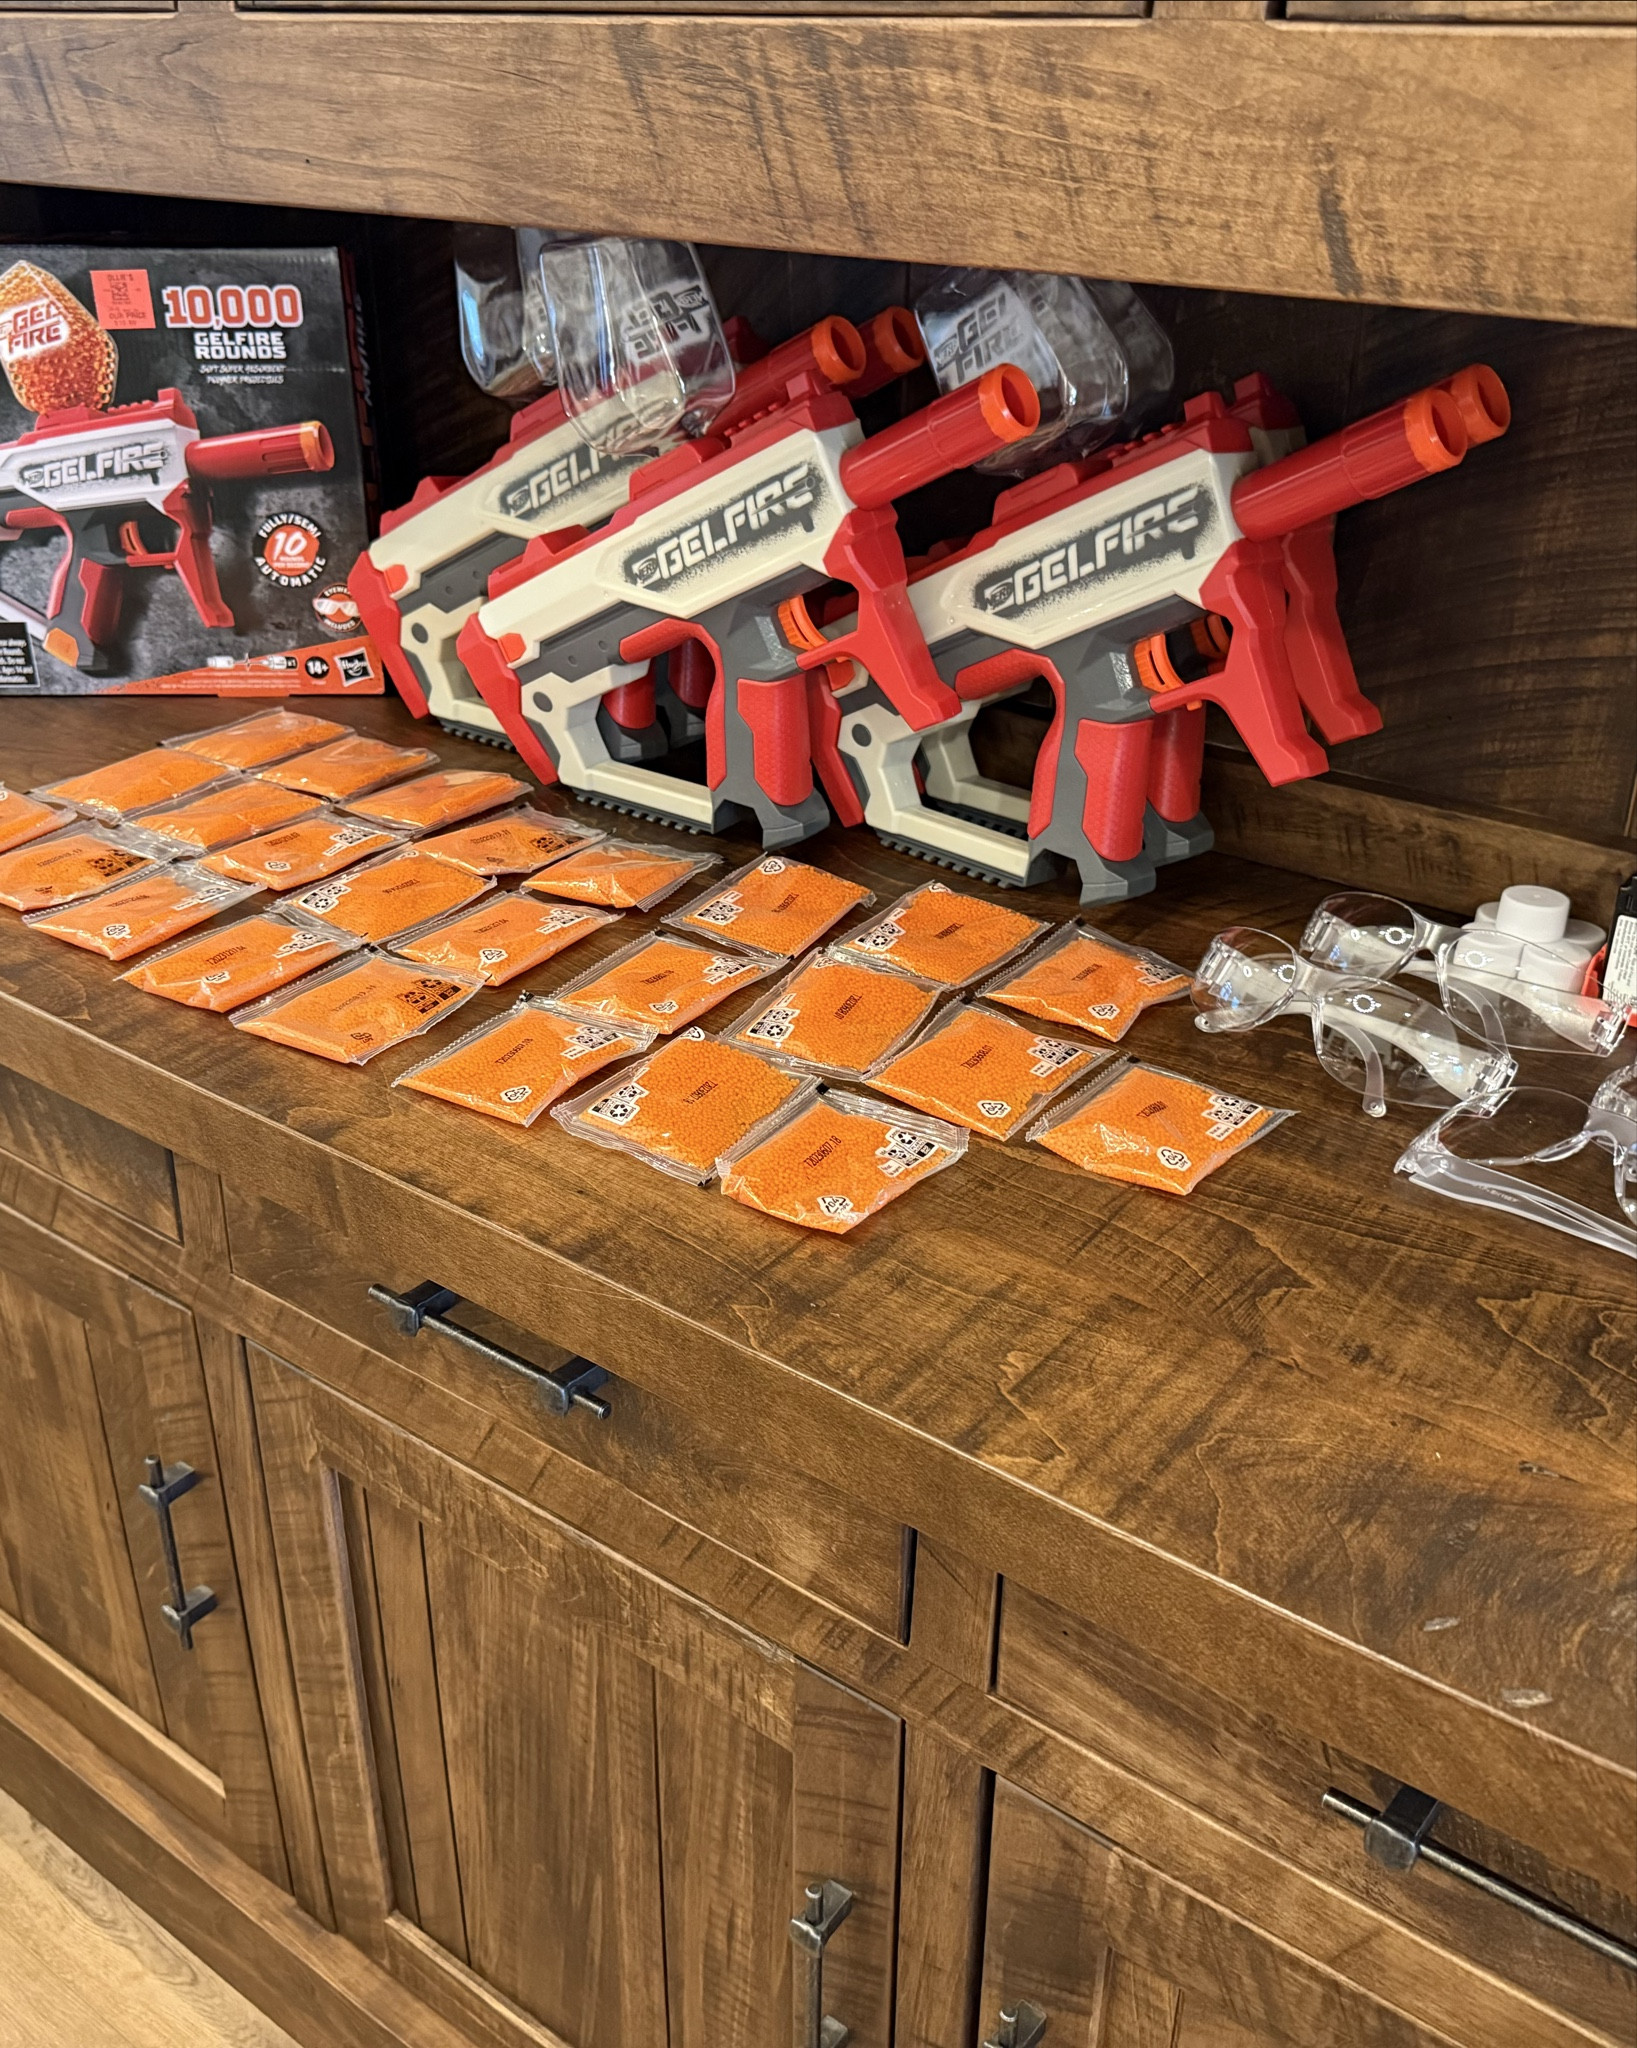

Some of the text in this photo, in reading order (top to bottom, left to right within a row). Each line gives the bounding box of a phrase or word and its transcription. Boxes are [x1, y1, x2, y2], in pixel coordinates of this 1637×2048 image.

[162, 285, 303, 331] 10,000
[8, 320, 62, 354] FIRE
[194, 331, 285, 346] GELFIRE
[195, 345, 288, 360] ROUNDS
[43, 441, 165, 488] GELFIRE
[258, 513, 322, 539] FULLY/SEMI
[657, 463, 815, 580] GELFIRE
[272, 530, 307, 561] 10
[1013, 486, 1199, 606] GELFIRE
[254, 556, 327, 588] AUTOMATIC
[308, 661, 329, 674] 14+
